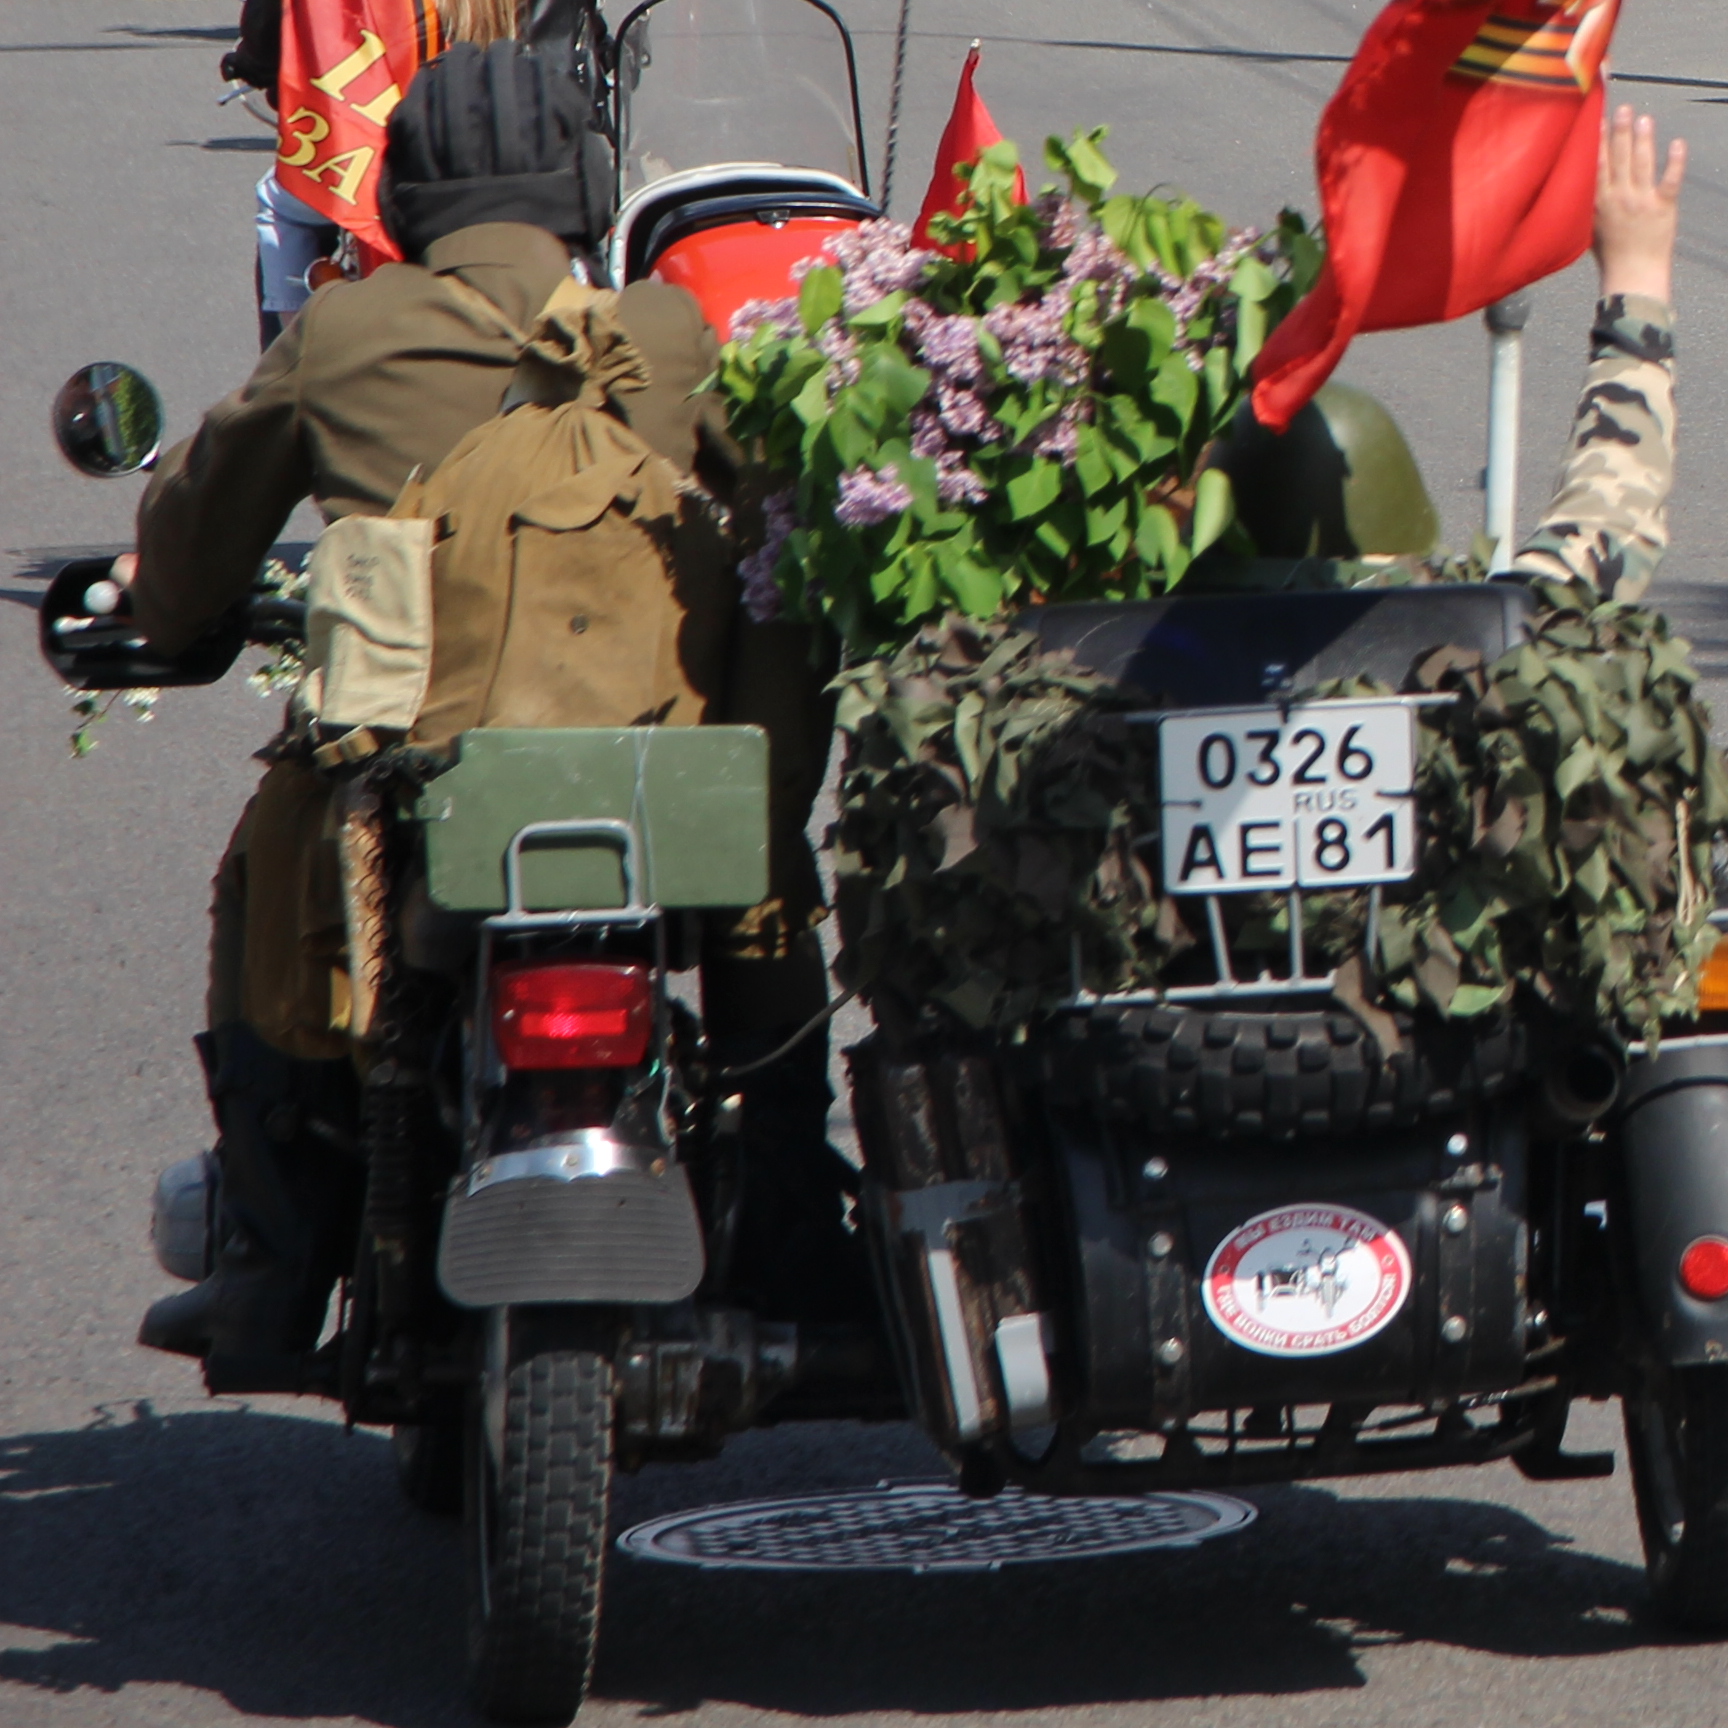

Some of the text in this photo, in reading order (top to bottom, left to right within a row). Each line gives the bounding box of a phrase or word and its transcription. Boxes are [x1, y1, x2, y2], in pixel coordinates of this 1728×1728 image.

[1197, 723, 1374, 791] 0326
[1293, 789, 1357, 814] RUS
[1314, 812, 1395, 873] 81
[1269, 1210, 1335, 1231] ЕЗДИМ
[1340, 1214, 1378, 1243] ТАМ
[1216, 1283, 1240, 1321] ГДЕ
[1234, 1310, 1287, 1348] ВОЛКИ
[1290, 1327, 1348, 1349] СРАТЬ
